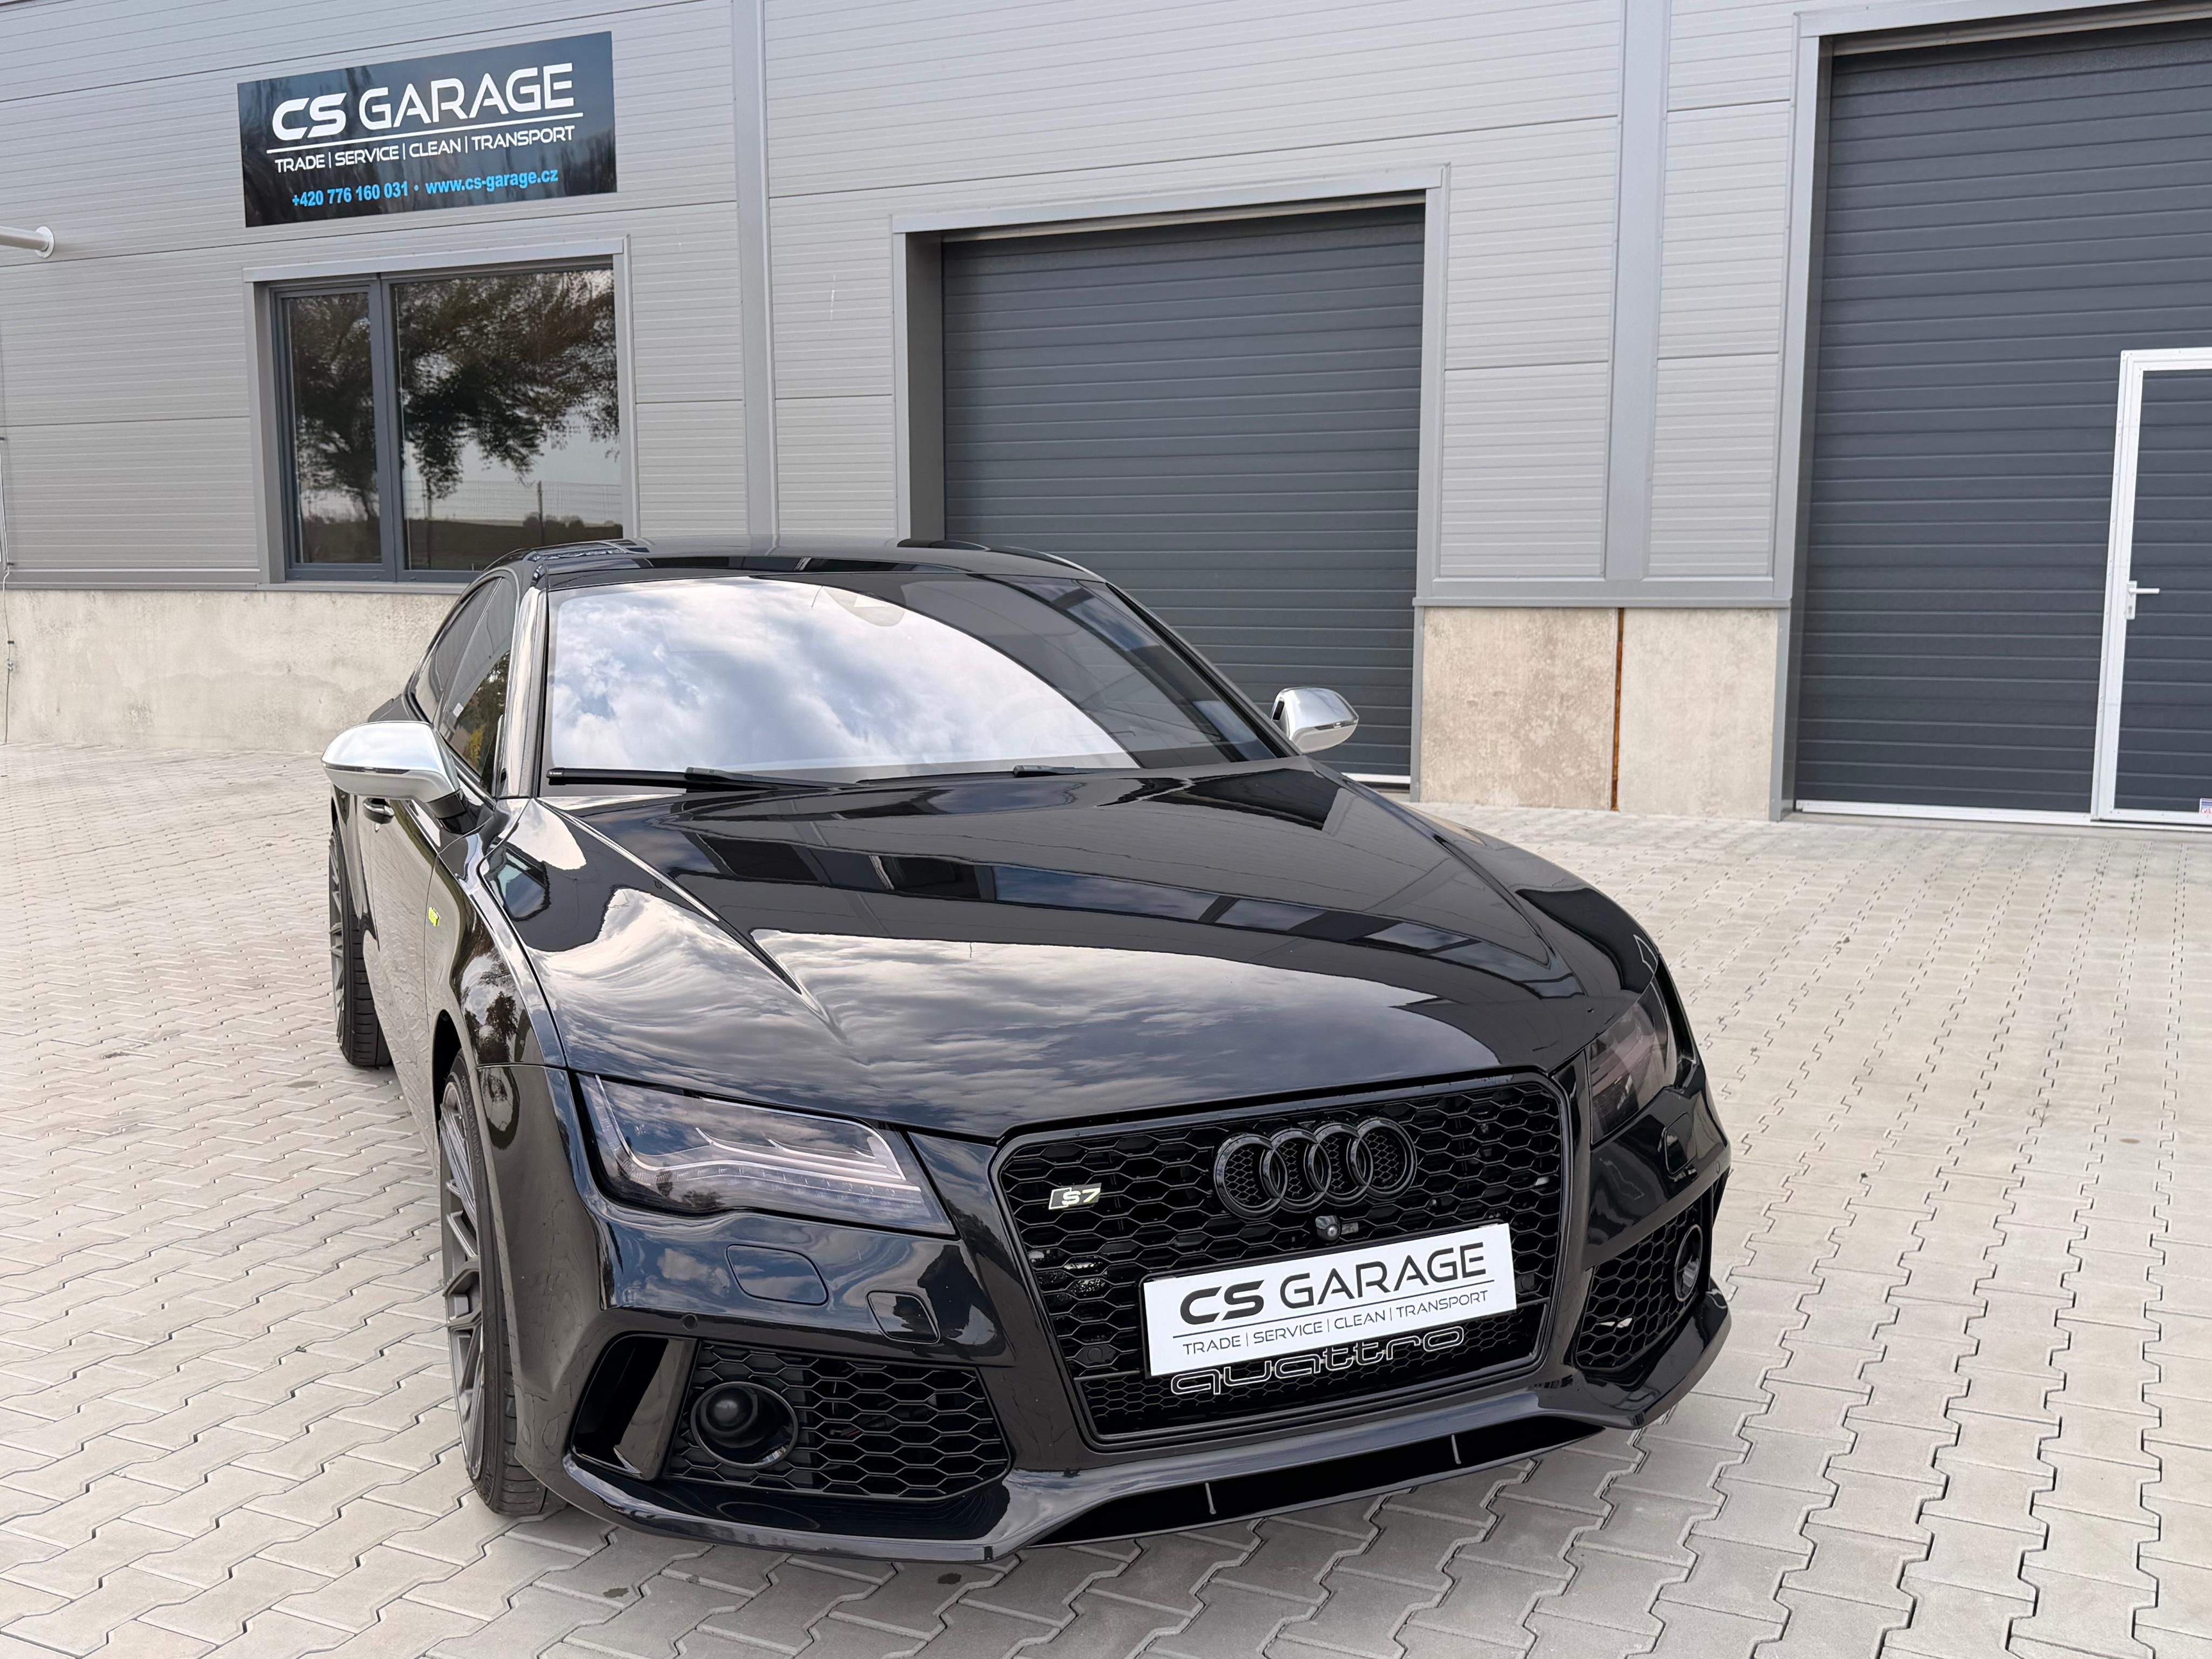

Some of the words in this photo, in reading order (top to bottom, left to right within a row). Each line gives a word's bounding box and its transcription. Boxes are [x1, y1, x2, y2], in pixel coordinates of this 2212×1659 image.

[272, 92, 347, 141] CS
[359, 63, 574, 130] GARAGE
[274, 153, 326, 173] TRADE
[335, 145, 400, 166] SERVICE
[409, 138, 461, 158] CLEAN
[471, 125, 575, 151] TRANSPORT
[292, 190, 324, 207] +420
[327, 187, 352, 204] 776
[356, 184, 380, 200] 160
[383, 181, 408, 199] 031
[425, 168, 558, 194] www.cs-garage.cz
[1061, 1187, 1101, 1206] S7
[1179, 1279, 1265, 1325] CS
[1280, 1242, 1487, 1310] GARAGE
[1183, 1335, 1242, 1355] TRADE
[1253, 1321, 1323, 1344] SERVICE
[1334, 1310, 1386, 1330] CLEAN
[1396, 1290, 1488, 1318] TRANSPORT
[1170, 1326, 1464, 1395] quattro
